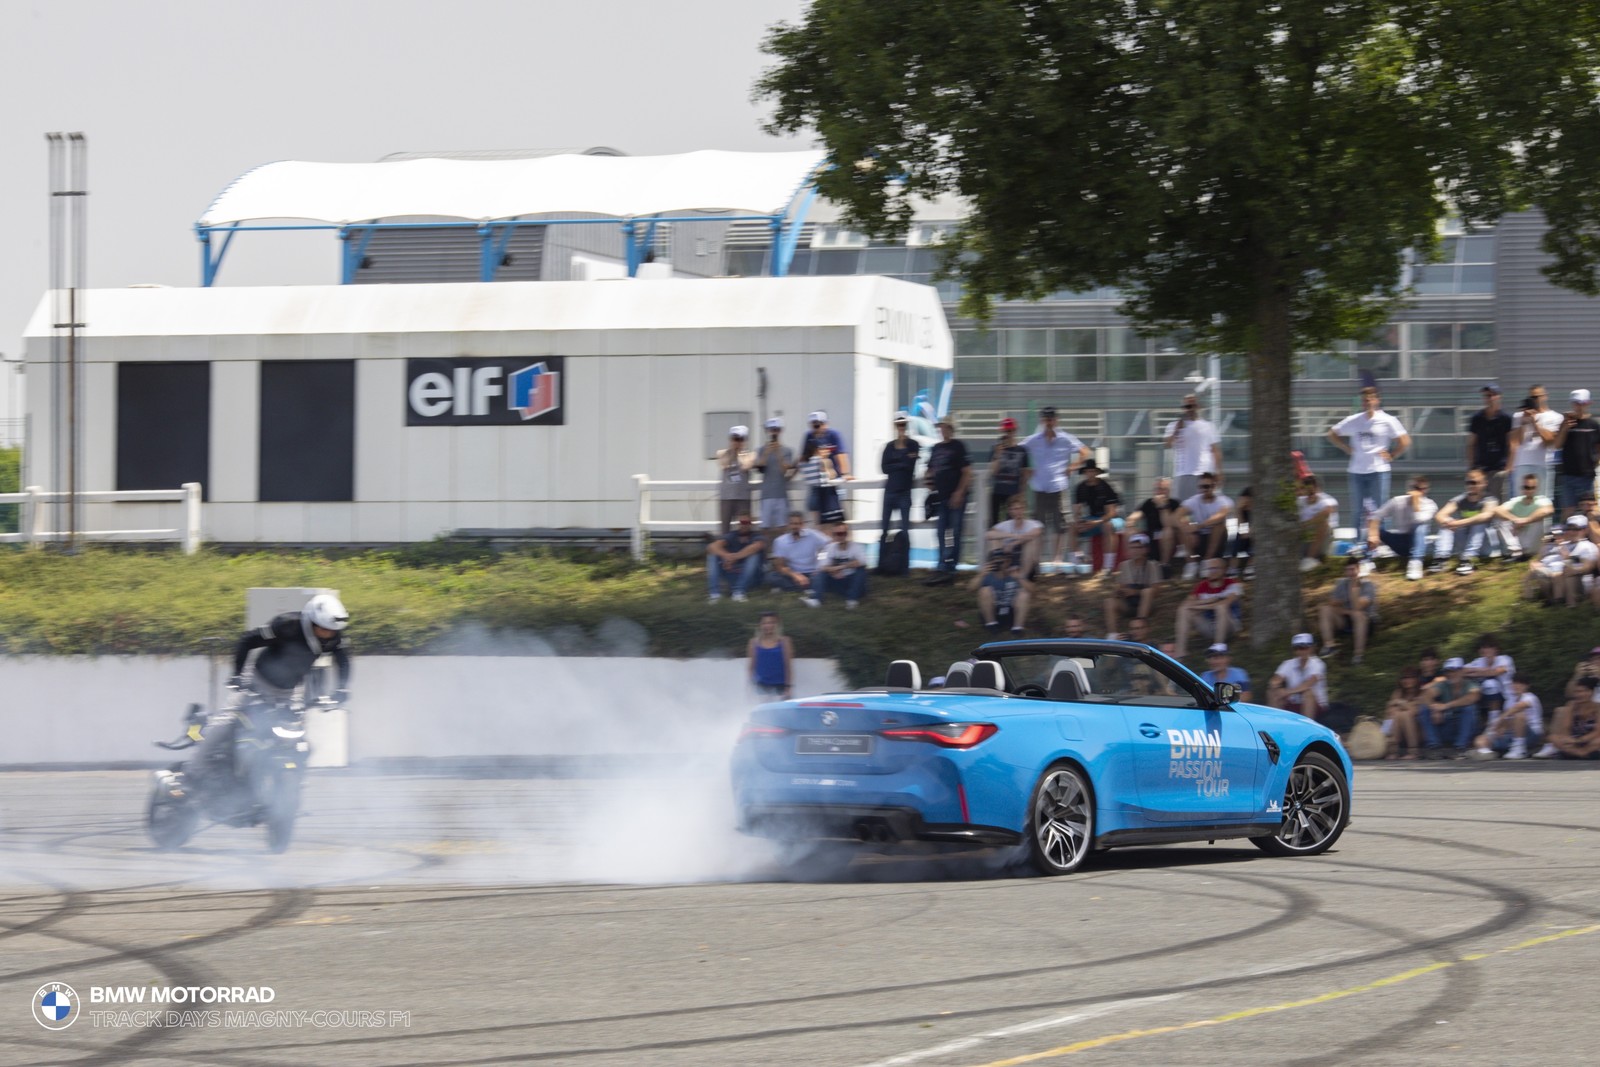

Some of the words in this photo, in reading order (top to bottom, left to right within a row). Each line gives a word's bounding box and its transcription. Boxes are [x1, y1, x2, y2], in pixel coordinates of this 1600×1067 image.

[408, 366, 503, 417] elf
[1166, 729, 1221, 759] BMW
[1168, 760, 1222, 779] PASSION
[1196, 778, 1229, 798] TOUR
